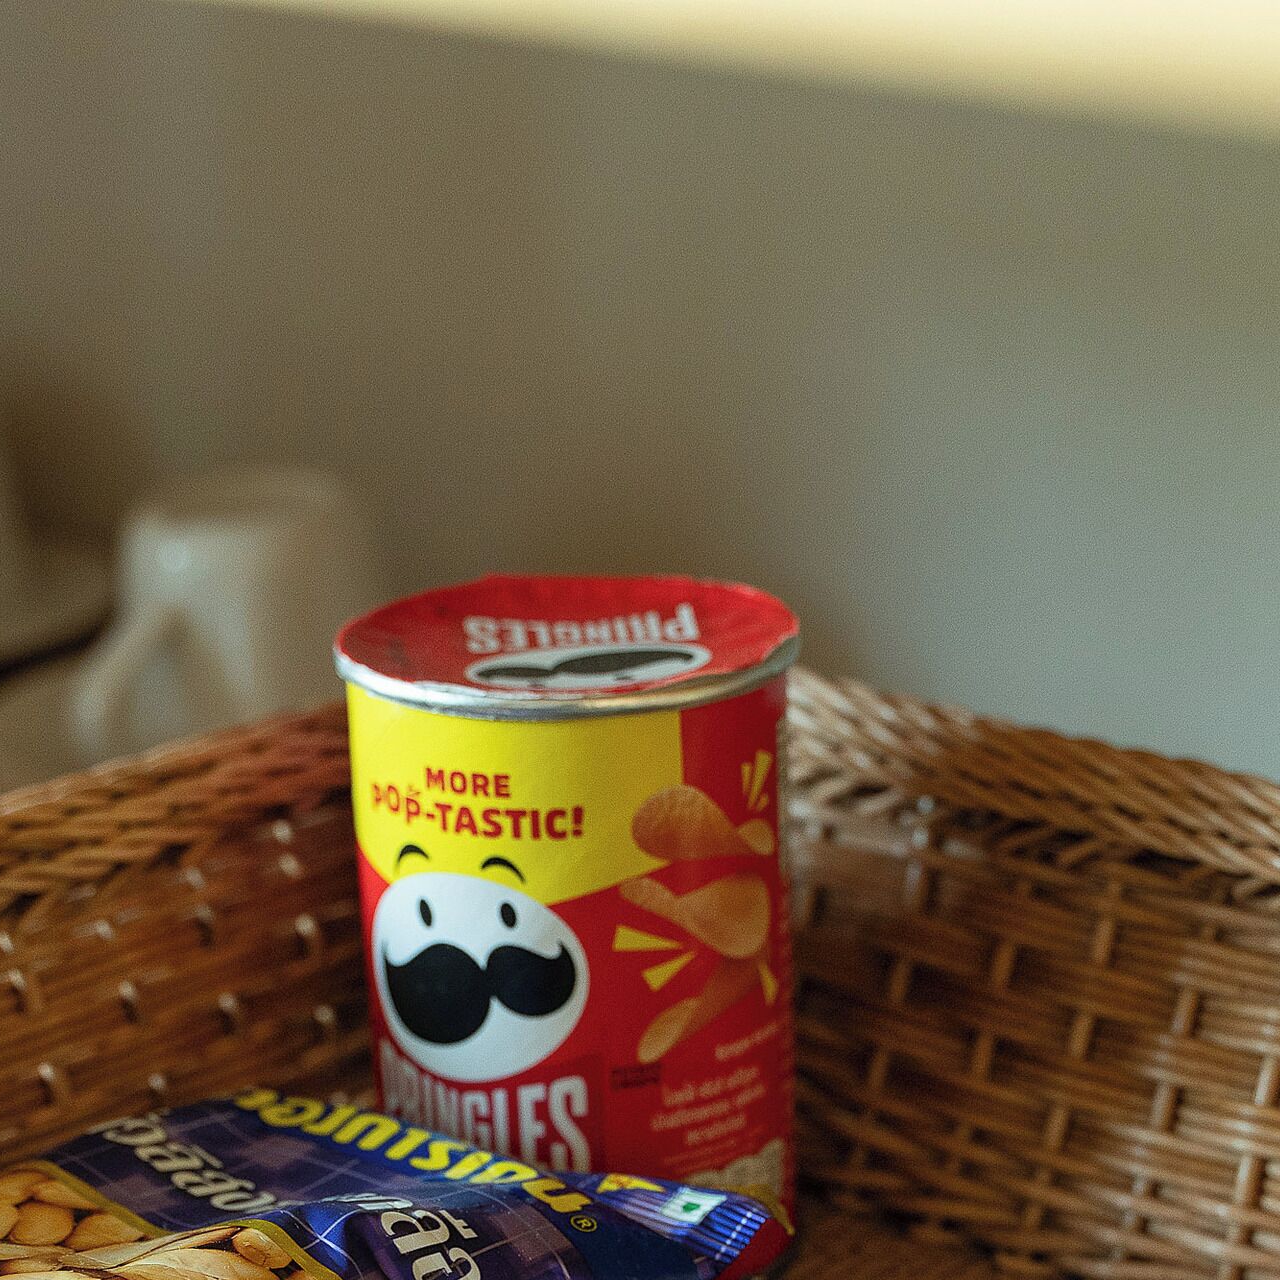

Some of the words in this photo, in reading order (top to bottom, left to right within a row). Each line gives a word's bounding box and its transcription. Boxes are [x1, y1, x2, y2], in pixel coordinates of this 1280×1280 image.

[464, 603, 700, 654] PRINGLES
[425, 768, 511, 798] MORE
[372, 785, 585, 841] POP-TASTIC!
